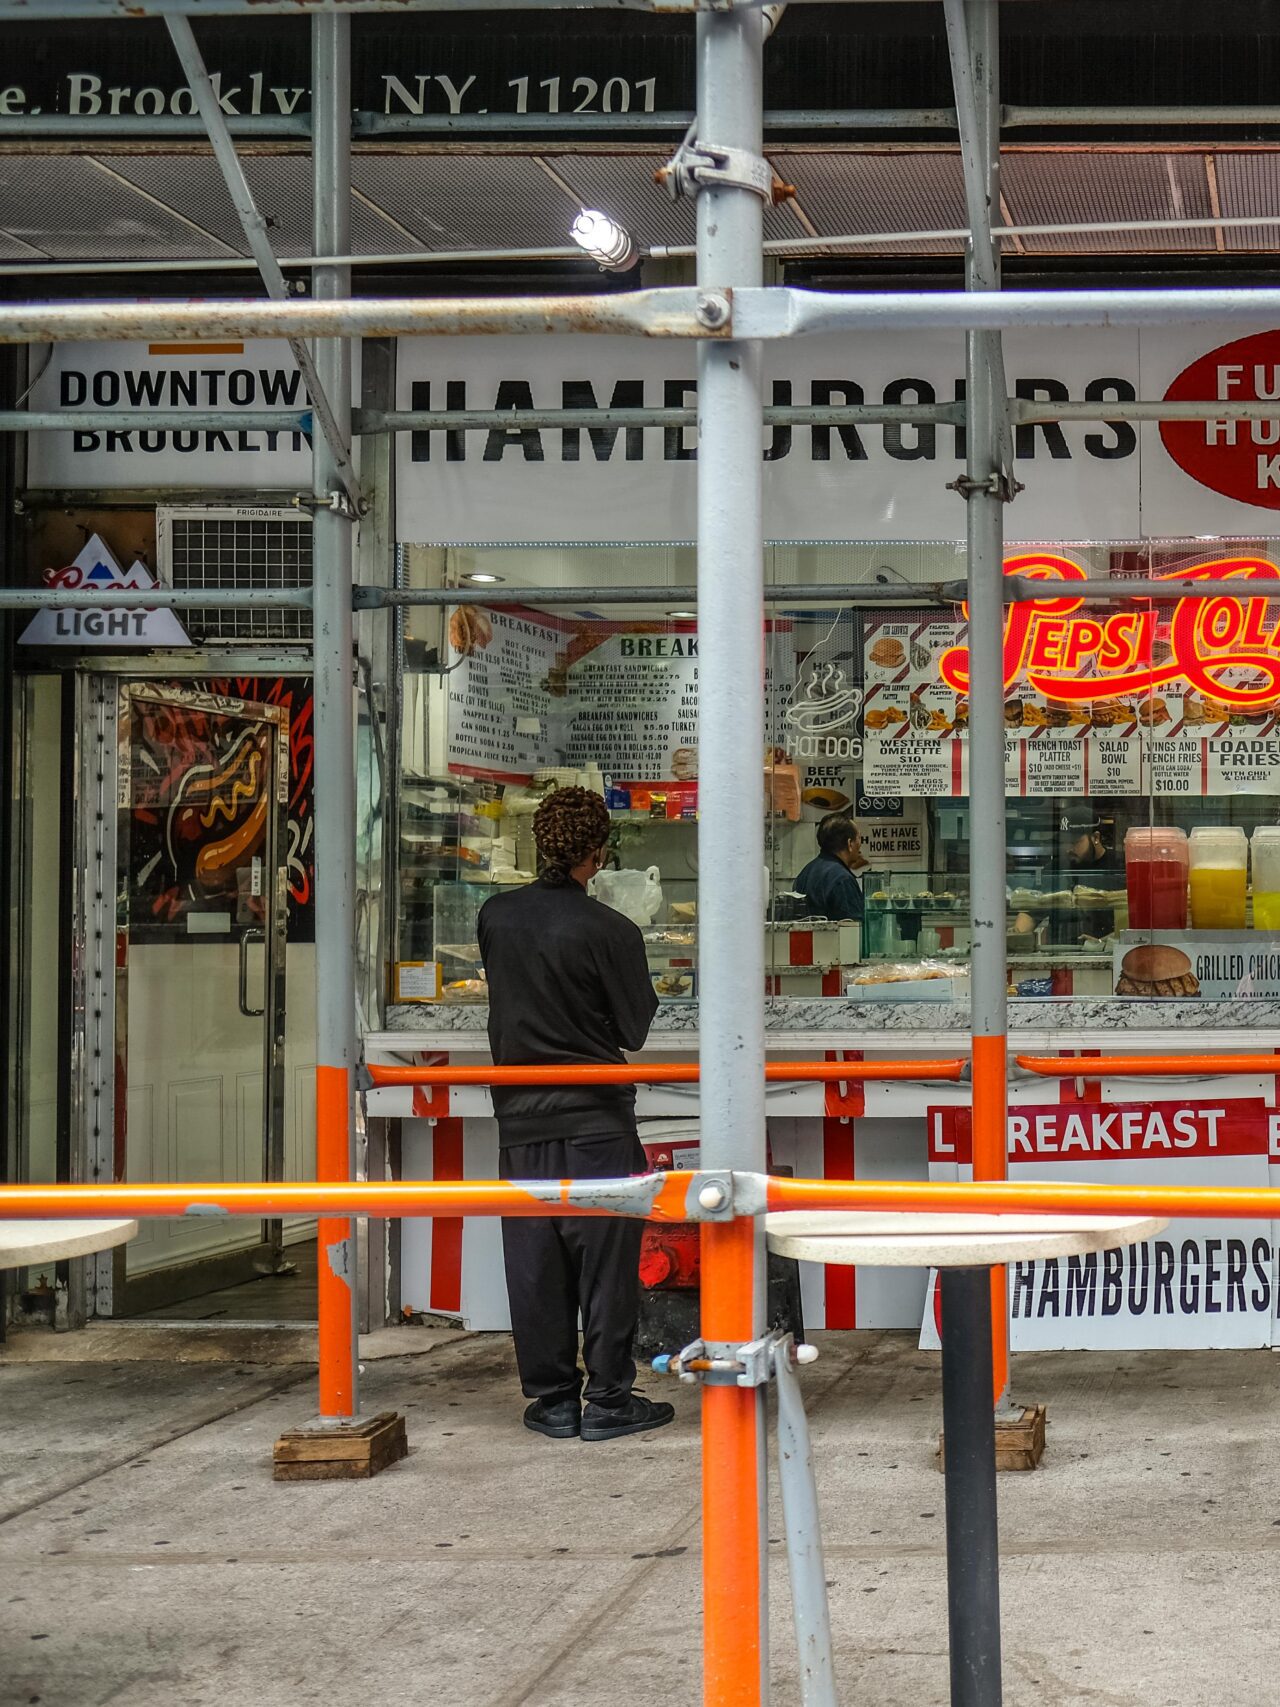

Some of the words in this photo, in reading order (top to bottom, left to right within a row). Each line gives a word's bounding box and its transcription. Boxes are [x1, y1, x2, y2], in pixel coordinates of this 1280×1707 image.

[67, 72, 312, 115] Brookly
[508, 76, 656, 113] 11201
[60, 369, 312, 407] DOWNTOW
[410, 377, 1138, 462] HAMRGRS
[236, 508, 284, 518] FRIGIDAIRE
[56, 612, 147, 637] LIGHT
[489, 612, 561, 644] BREAKFAST
[938, 553, 1160, 696] PEPSI
[620, 638, 699, 657] BREAK
[578, 712, 614, 721] BREAKFAST
[616, 711, 658, 721] SANDWICHES
[671, 721, 696, 731] TURKEY
[455, 733, 477, 744] BOTTLE
[880, 739, 941, 748] WESTERN
[786, 735, 824, 759] HOT
[826, 736, 863, 759] DOG
[880, 747, 942, 755] OMELETTE
[1028, 740, 1057, 751] FRENCH
[1058, 740, 1083, 751] TOAST
[1099, 741, 1129, 752] SALAD
[1178, 741, 1197, 752] AND
[899, 755, 922, 763] $10
[1039, 752, 1071, 761] PLATTER
[1101, 753, 1127, 764] BOWL
[1178, 753, 1202, 763] FRIES
[1220, 753, 1280, 766] FRIES
[807, 766, 842, 776] BEEF
[1028, 763, 1042, 773] $10
[1107, 767, 1121, 777] $10
[804, 777, 846, 787] PATTY
[1155, 780, 1189, 792] $10.00
[872, 828, 887, 838] WE
[891, 828, 918, 838] HAVE
[869, 840, 895, 852] HOME
[897, 840, 921, 852] FRIES
[1196, 954, 1244, 981] GRILLED
[1007, 1109, 1226, 1154] REAKFAST
[1011, 1237, 1272, 1319] HAMBURGERS
